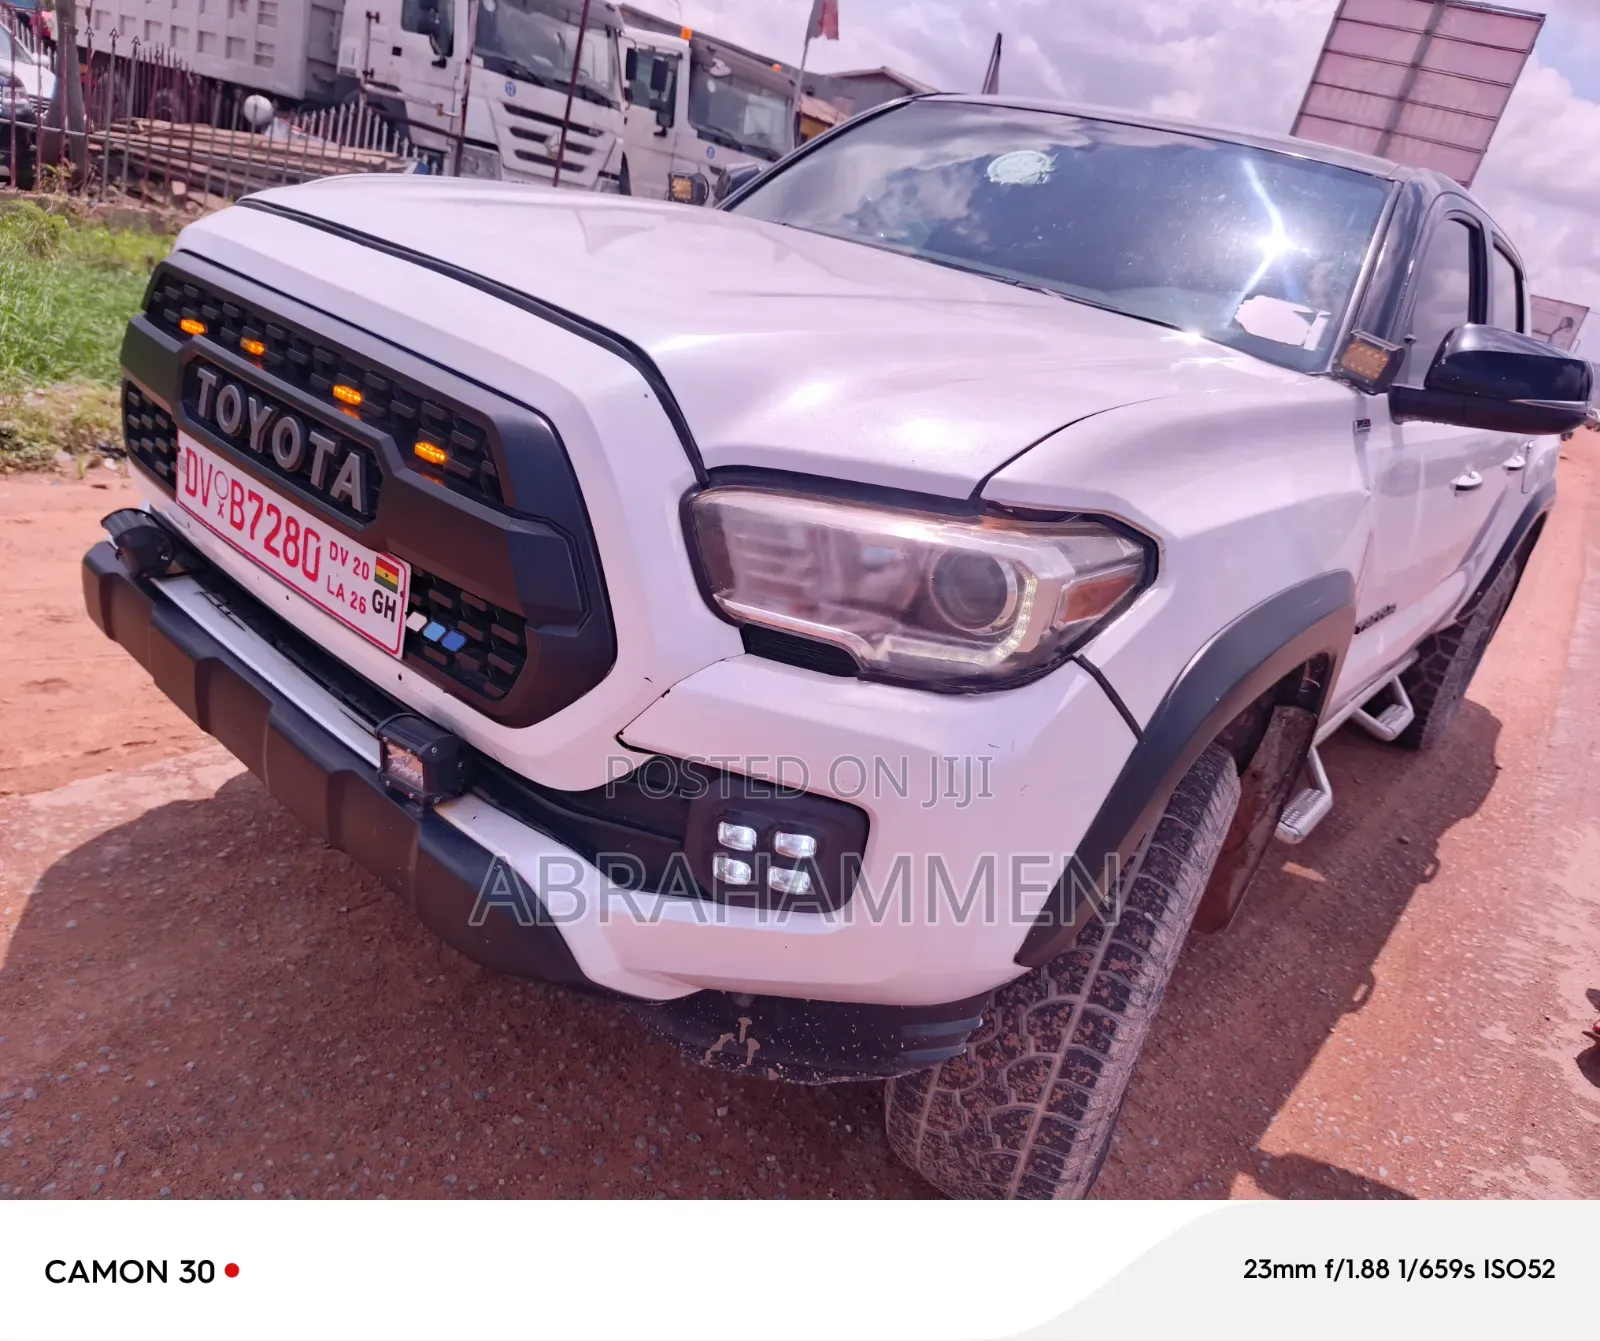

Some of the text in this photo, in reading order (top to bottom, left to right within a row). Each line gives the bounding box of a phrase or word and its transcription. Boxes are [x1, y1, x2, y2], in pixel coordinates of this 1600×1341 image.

[196, 366, 370, 515] TOYOTA
[185, 446, 322, 583] DV B7280
[329, 540, 370, 581] DV 20
[327, 574, 367, 615] LA 26
[372, 588, 397, 623] GH
